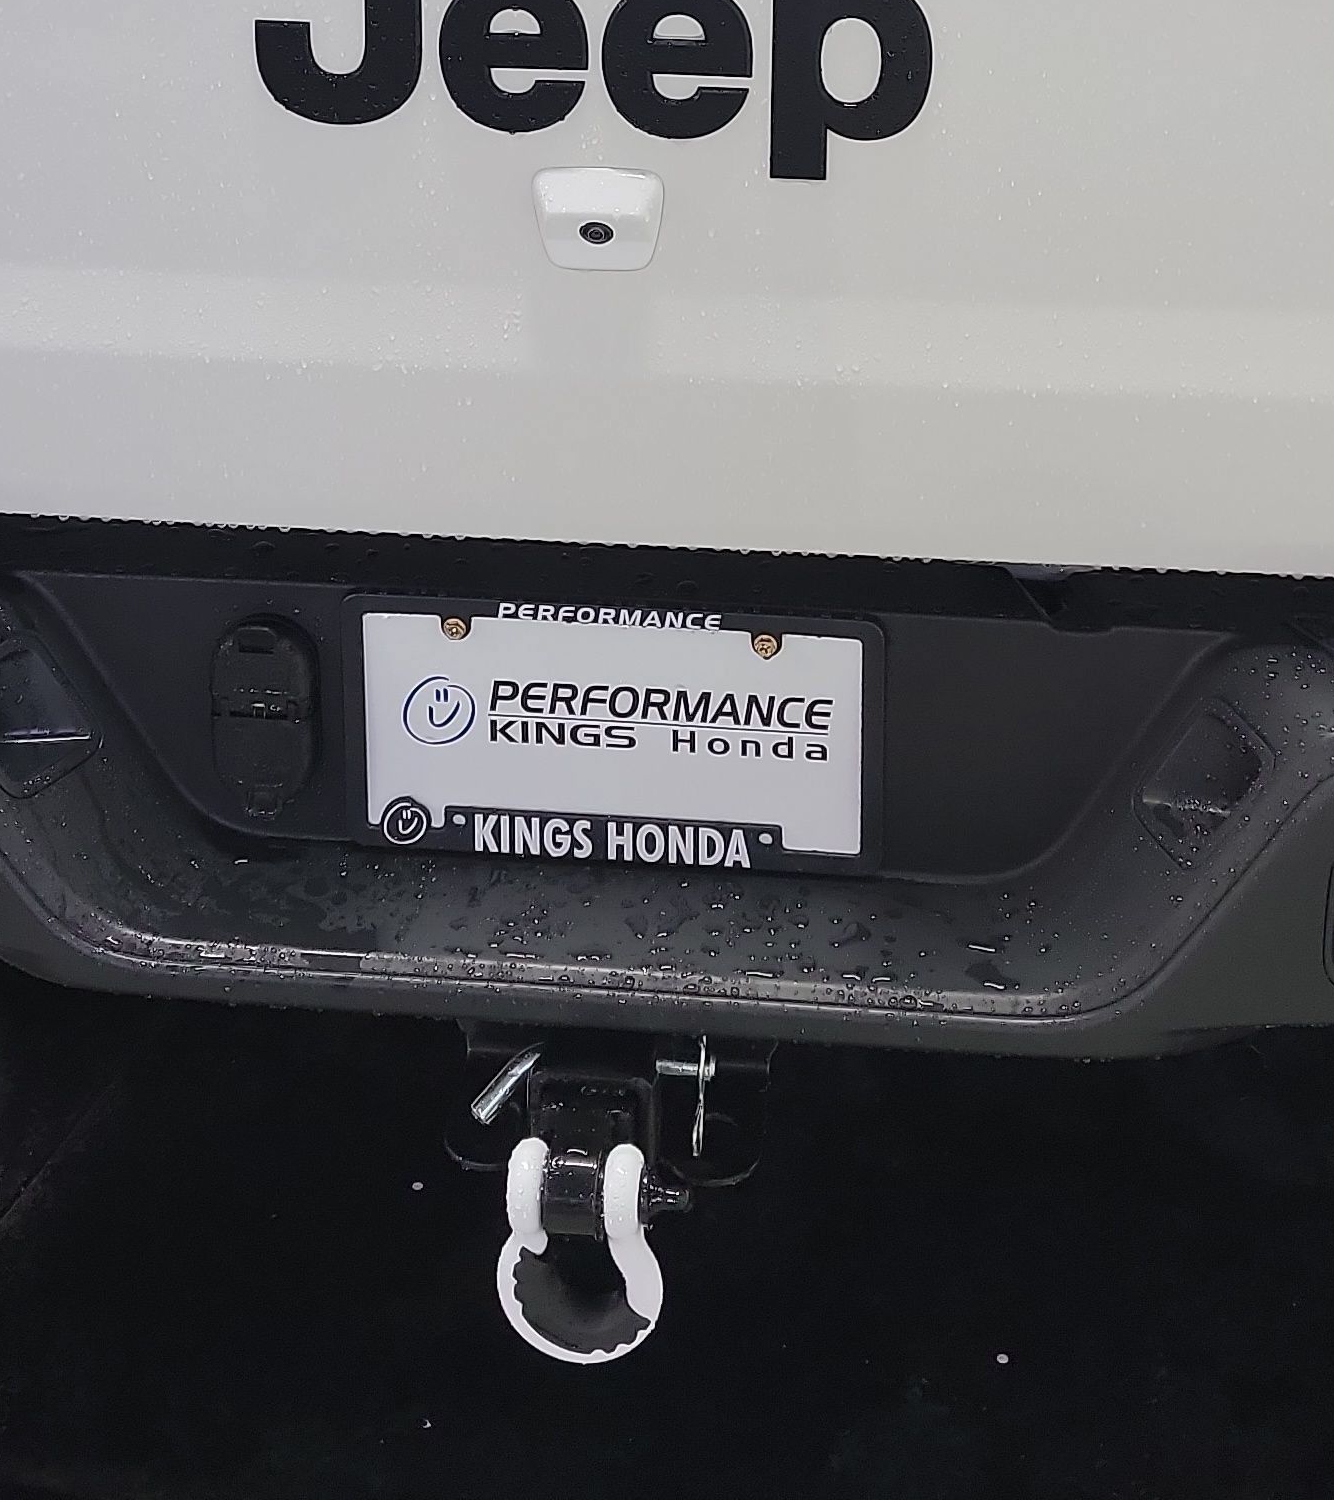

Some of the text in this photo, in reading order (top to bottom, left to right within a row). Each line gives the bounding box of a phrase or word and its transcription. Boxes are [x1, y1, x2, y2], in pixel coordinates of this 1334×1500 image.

[497, 602, 723, 631] PERFORMANCE
[489, 680, 834, 730] PERFORMANCE
[489, 719, 829, 762] KINGS Honda
[473, 812, 751, 868] KINGS HONDA
